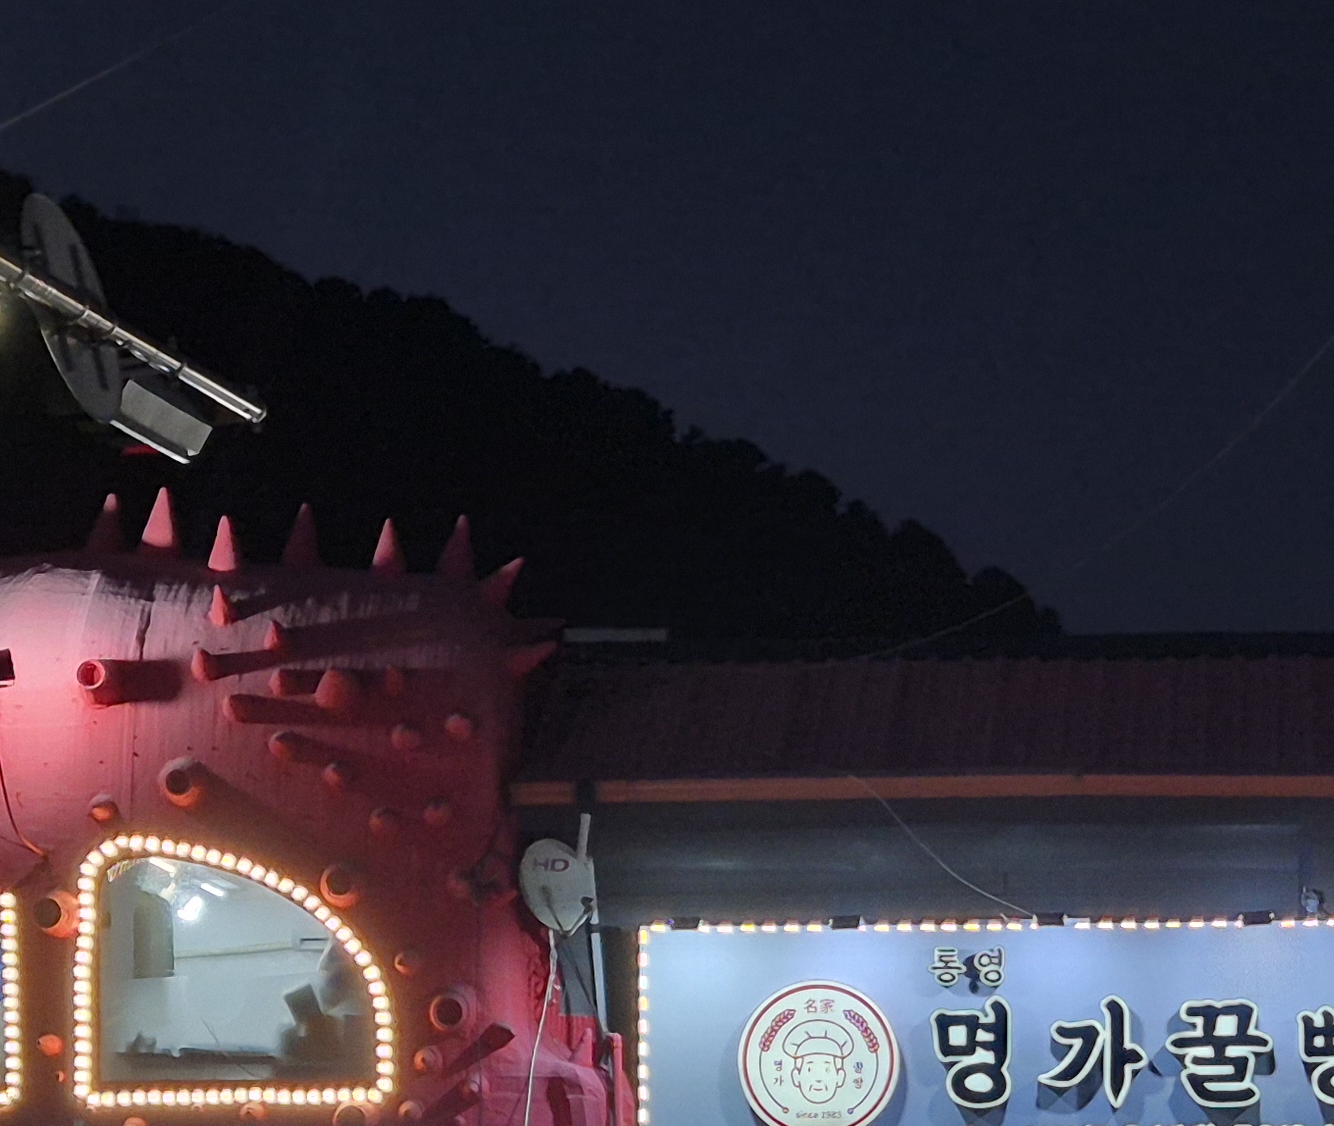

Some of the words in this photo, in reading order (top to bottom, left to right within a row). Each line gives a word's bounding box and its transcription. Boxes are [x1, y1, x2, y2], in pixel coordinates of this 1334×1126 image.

[532, 858, 569, 872] HD
[930, 946, 1005, 986] 통영
[803, 998, 836, 1014] 名家
